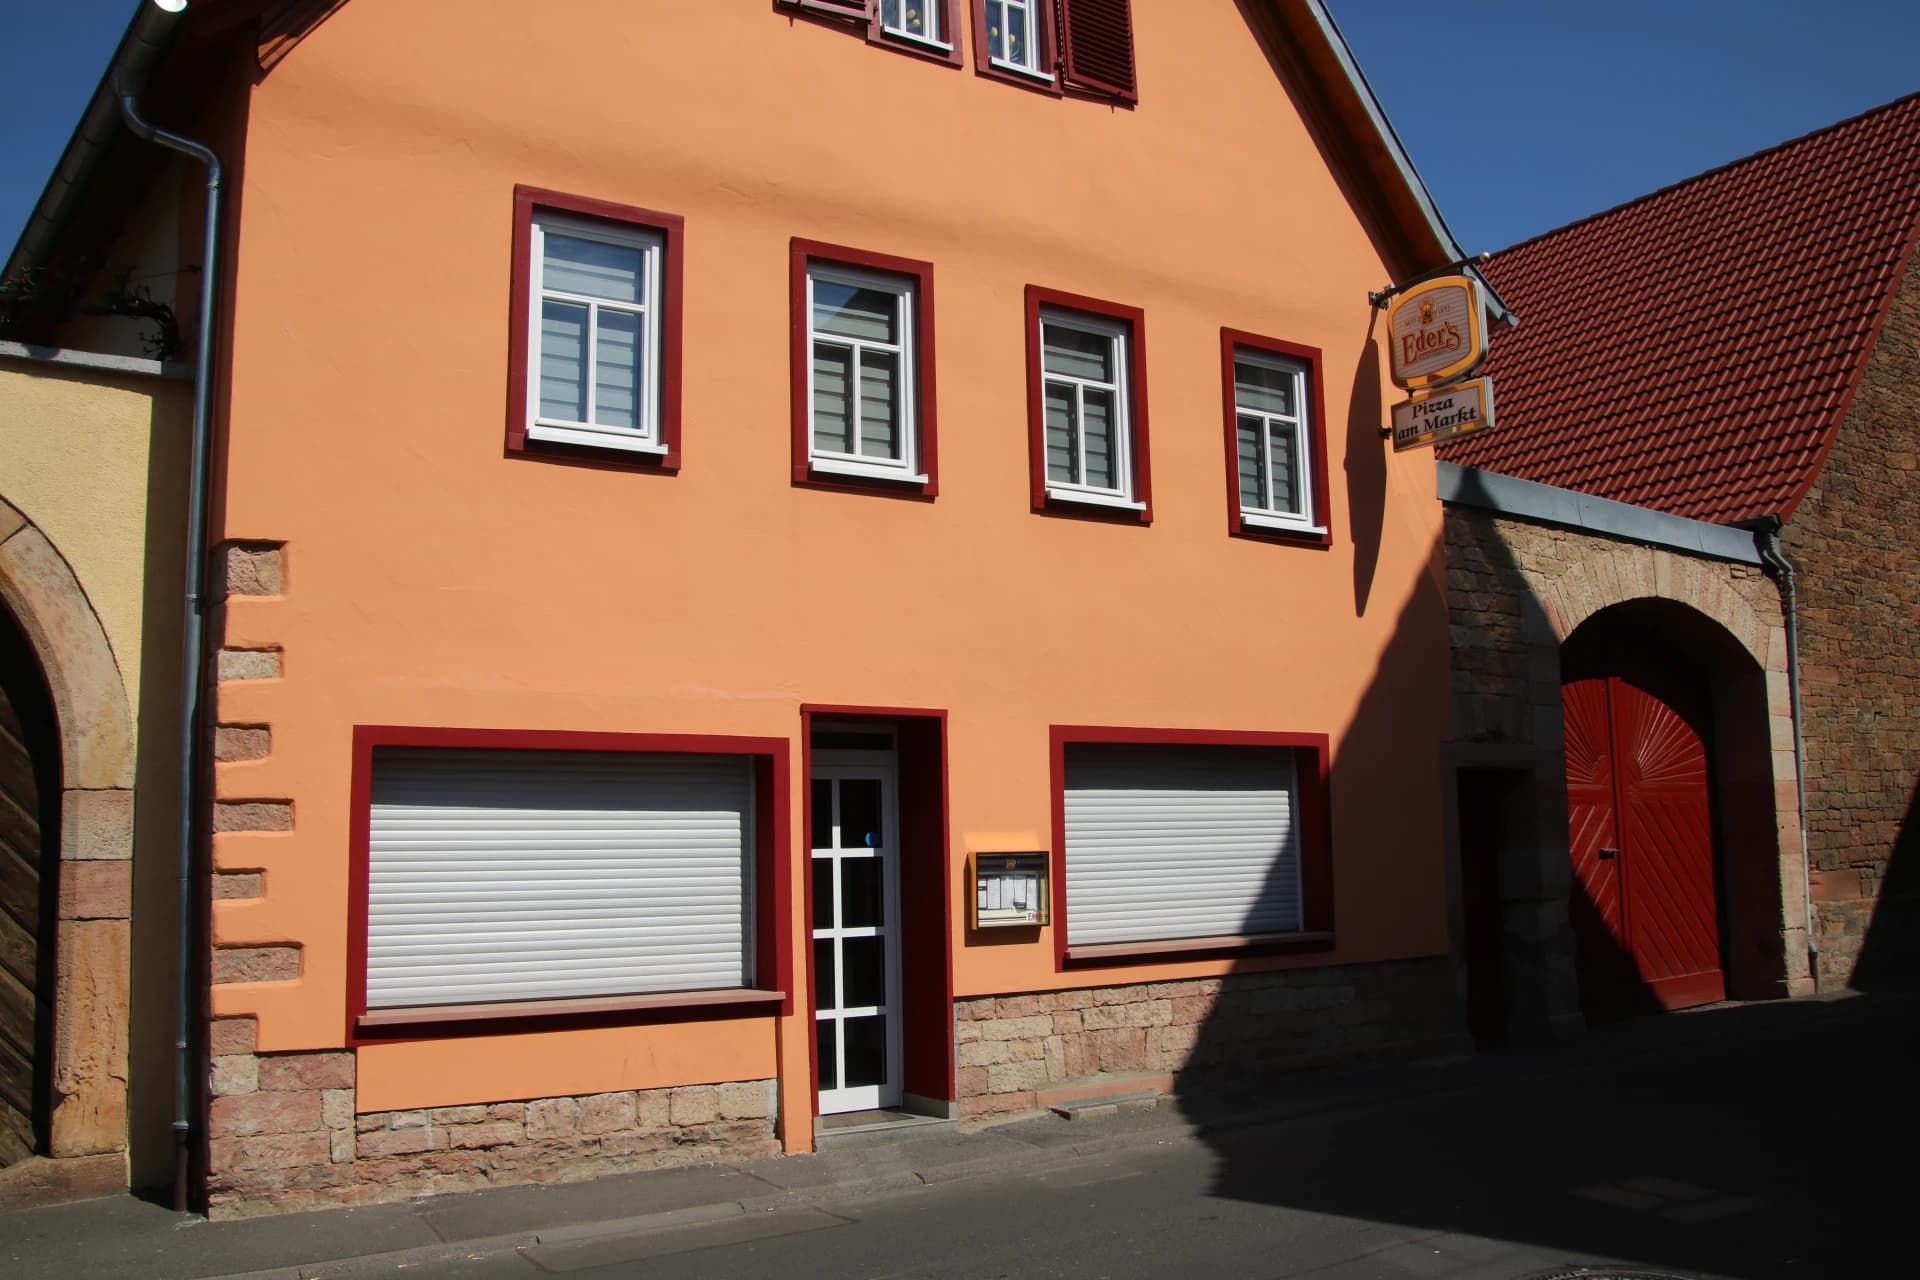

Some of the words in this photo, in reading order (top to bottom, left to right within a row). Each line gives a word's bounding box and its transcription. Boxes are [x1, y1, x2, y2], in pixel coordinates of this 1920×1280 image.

[1402, 321, 1461, 365] Eder's
[1398, 425, 1419, 440] am
[1424, 406, 1477, 432] Markt
[1411, 397, 1454, 419] Pizza
